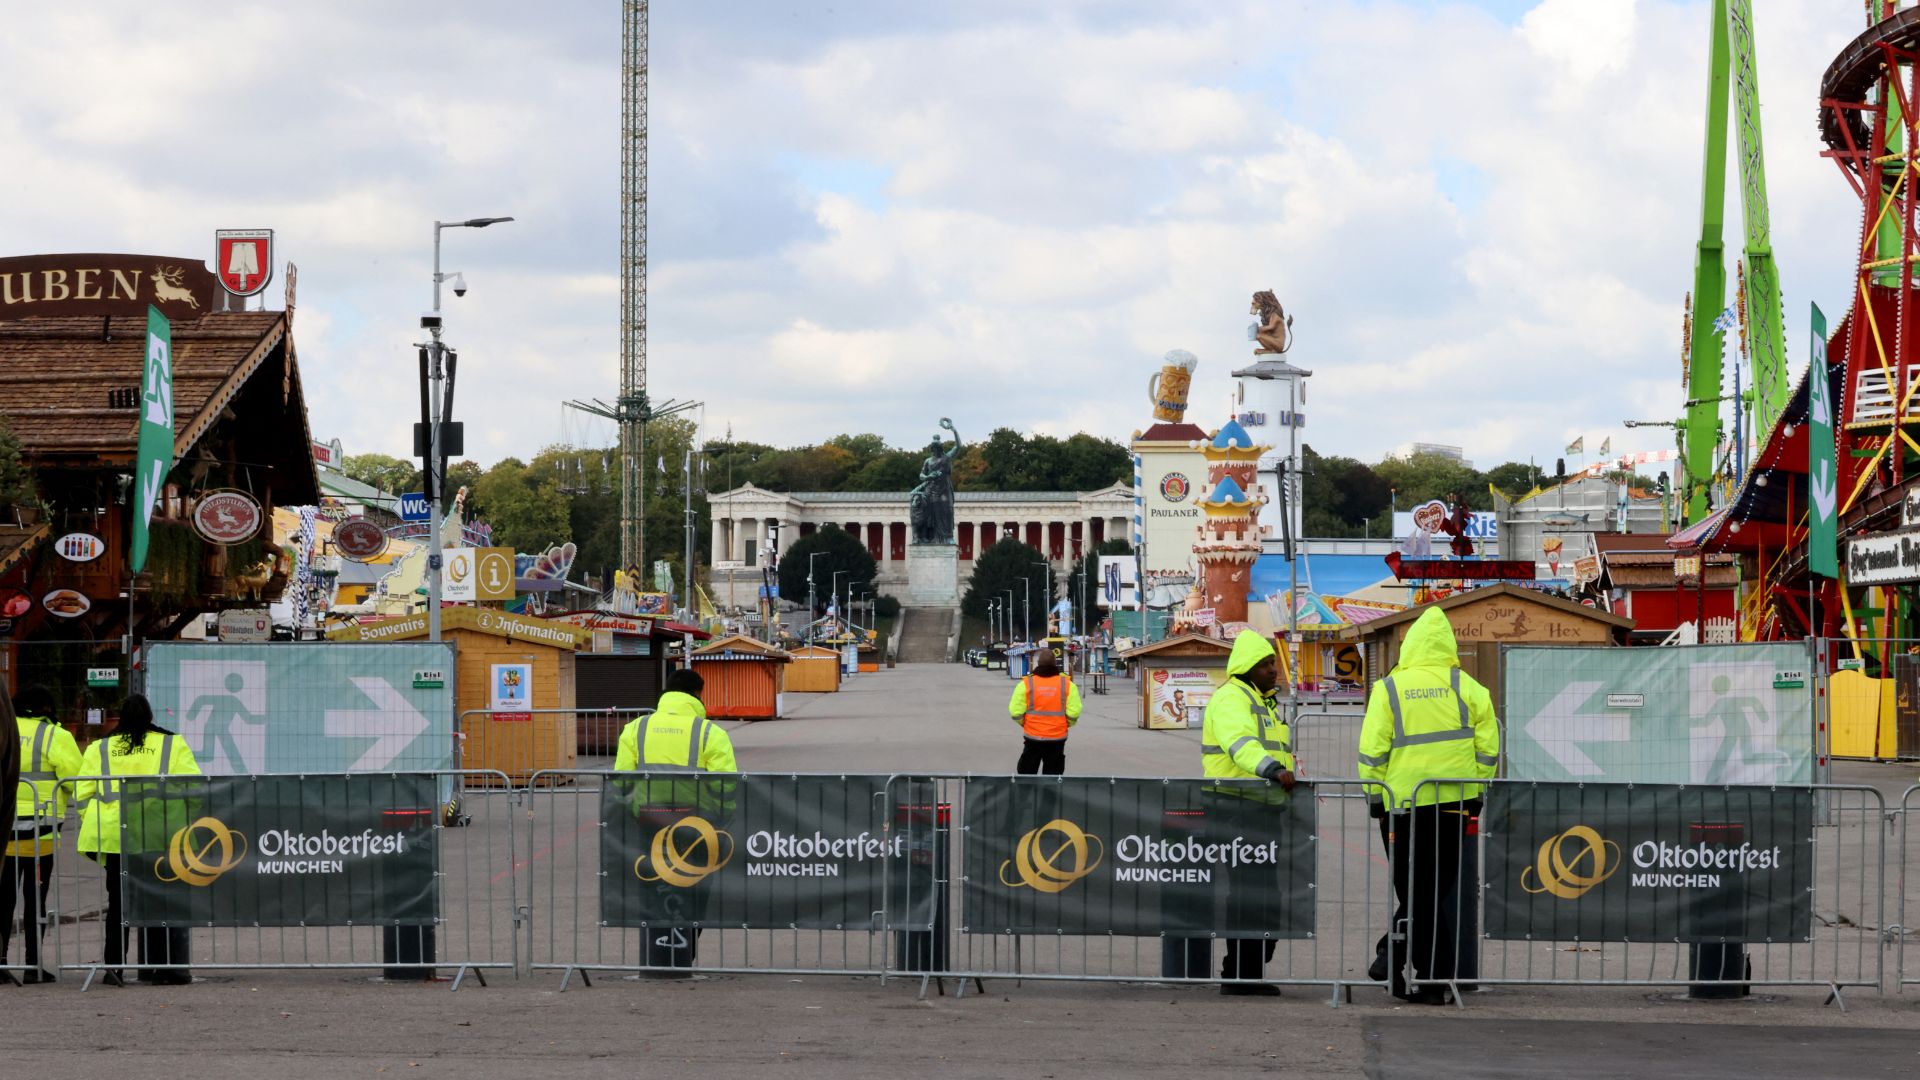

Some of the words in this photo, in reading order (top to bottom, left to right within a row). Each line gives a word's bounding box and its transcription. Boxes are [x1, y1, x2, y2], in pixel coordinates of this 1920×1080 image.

[0, 268, 143, 305] UBEN
[402, 499, 428, 514] WC
[1151, 508, 1199, 517] PAULANER
[1485, 603, 1515, 622] Zur
[360, 618, 425, 641] Souvenirs
[495, 616, 575, 643] Information
[1548, 622, 1581, 638] Hex
[1335, 646, 1362, 677] S
[1404, 688, 1450, 700] SECURITY
[111, 747, 156, 757] SECURITY
[258, 828, 404, 859] Oktoberfest
[746, 831, 903, 862] Oktoberfest
[1116, 834, 1278, 868] Oktoberfest
[1632, 840, 1780, 873] Oktoberfest
[257, 860, 343, 874] MÜNCHEN
[747, 863, 838, 877] MÜNCHEN
[1115, 867, 1211, 883] MÜNCHEN
[1632, 873, 1720, 888] MÜNCHEN
